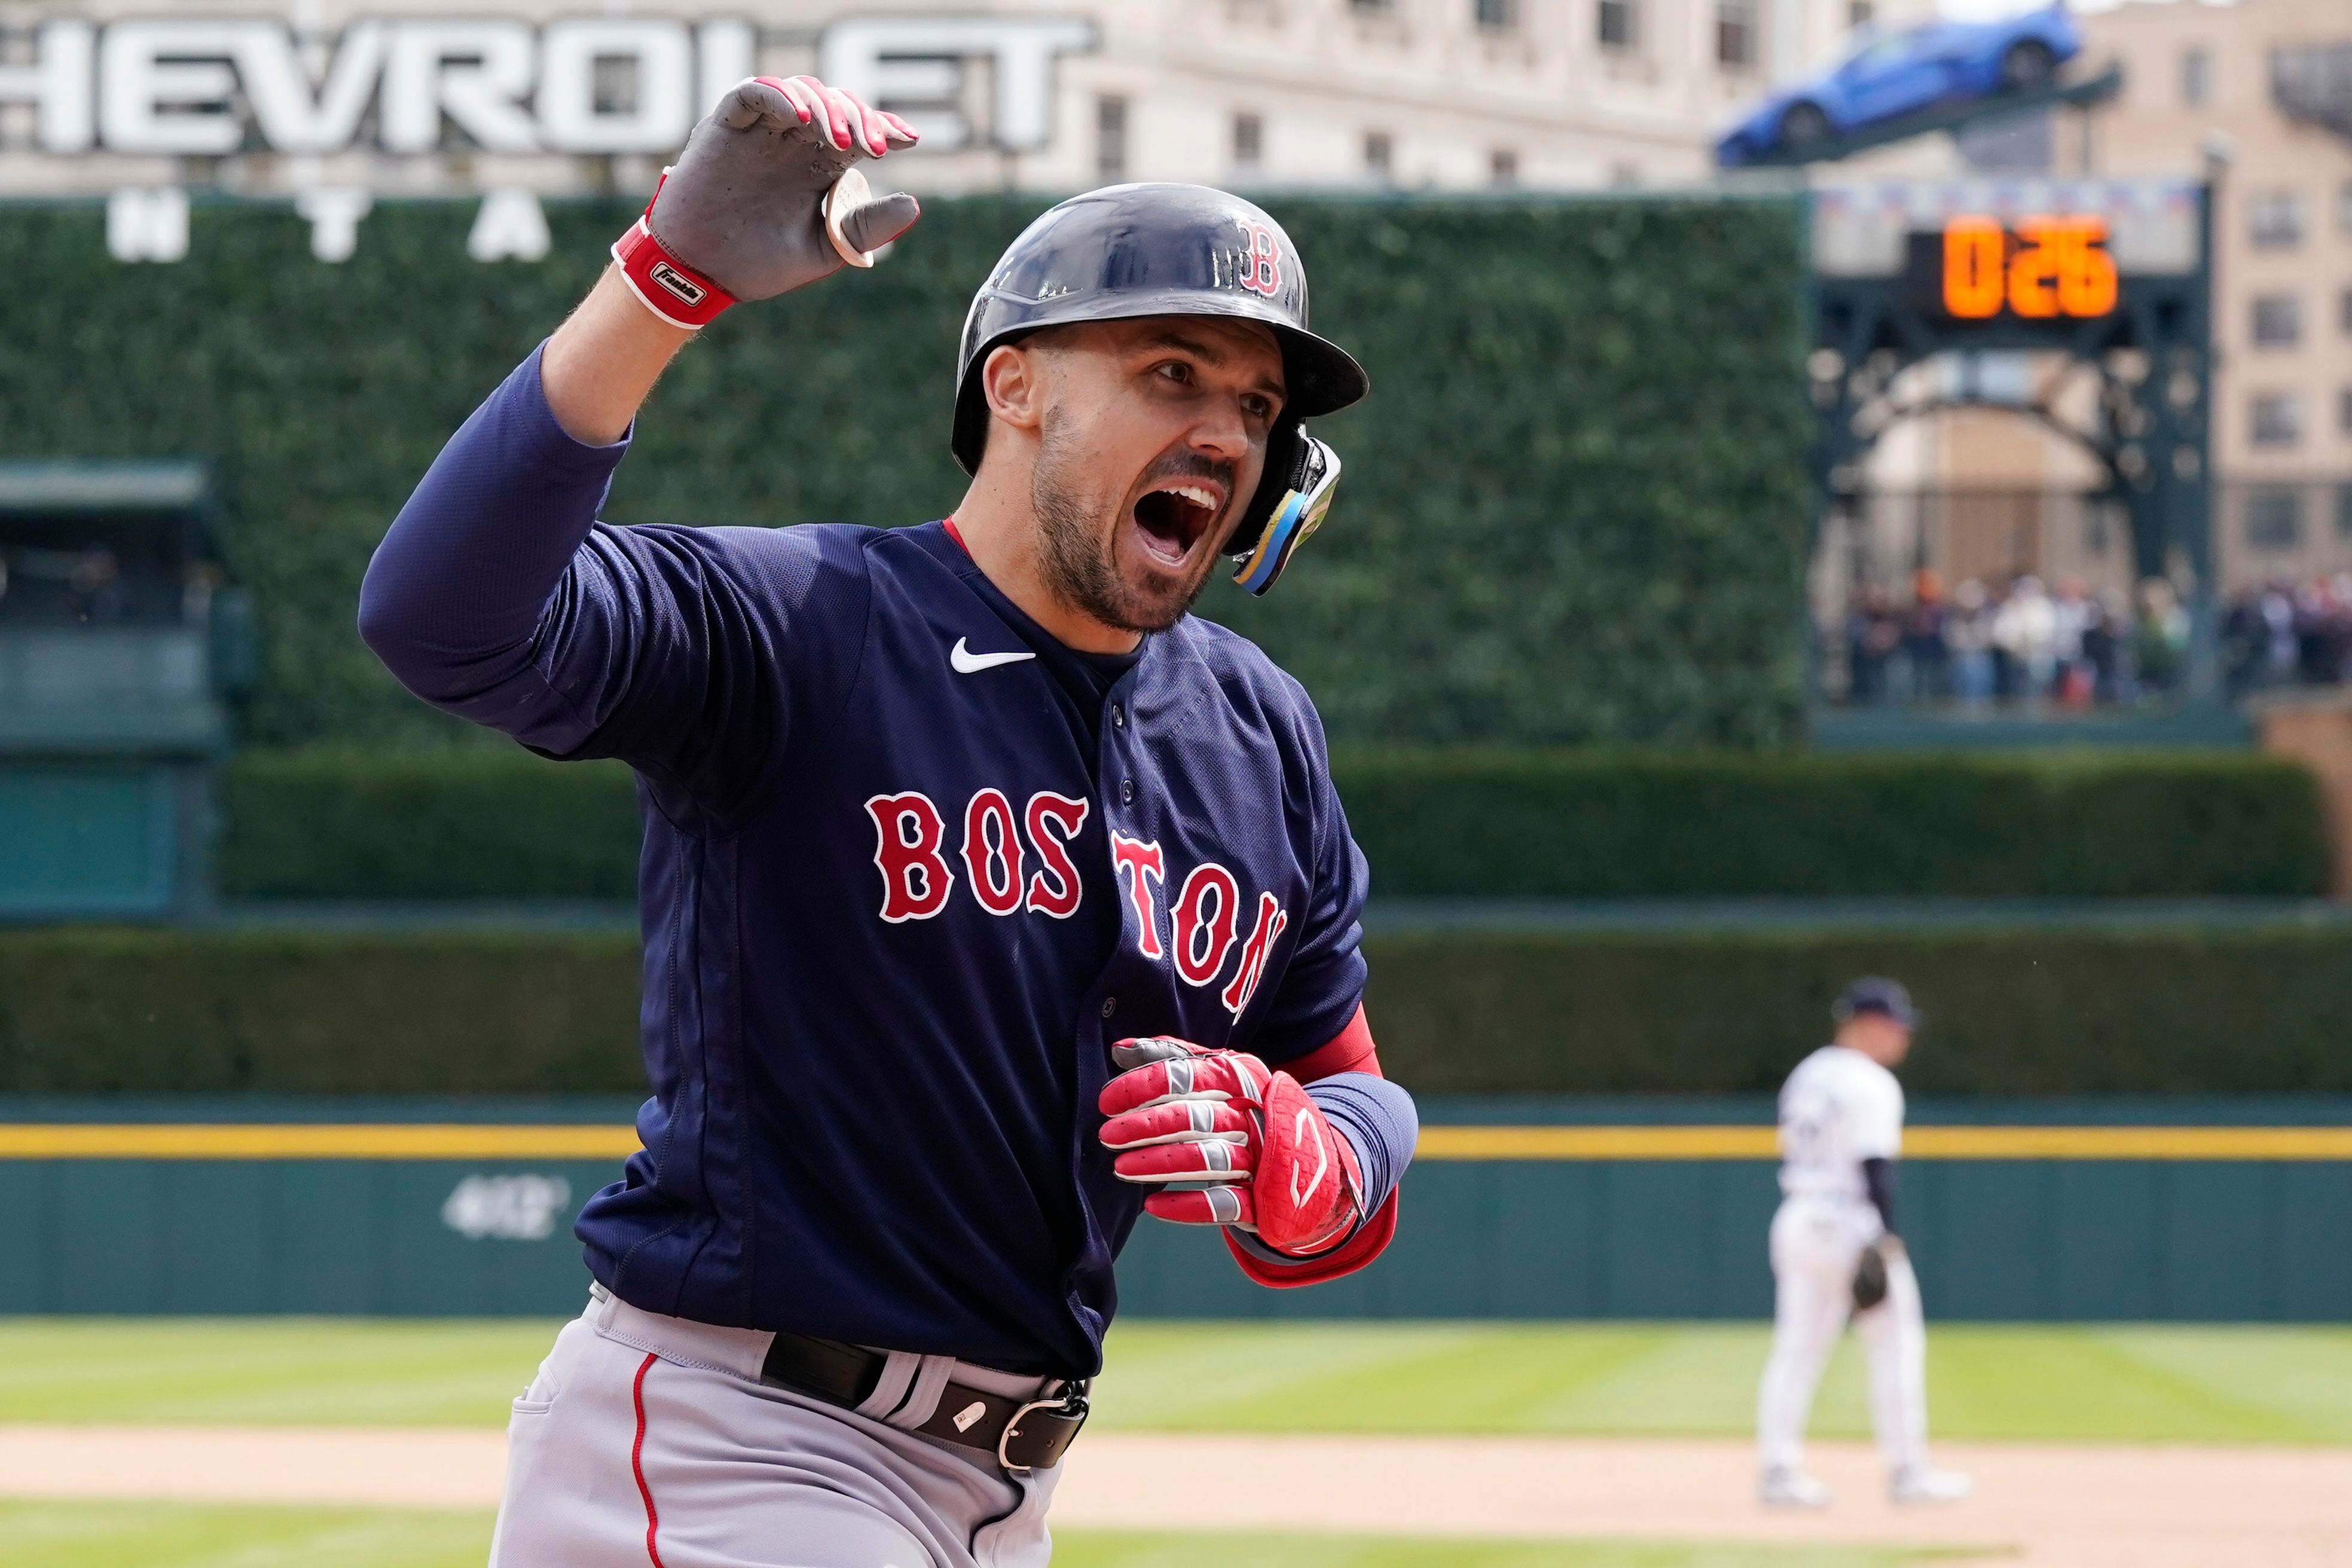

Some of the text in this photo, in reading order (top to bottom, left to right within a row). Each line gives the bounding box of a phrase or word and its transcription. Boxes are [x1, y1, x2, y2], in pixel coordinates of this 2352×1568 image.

[655, 268, 699, 299] Franklin
[1236, 219, 1284, 298] B
[863, 787, 1288, 1026] BOSTON
